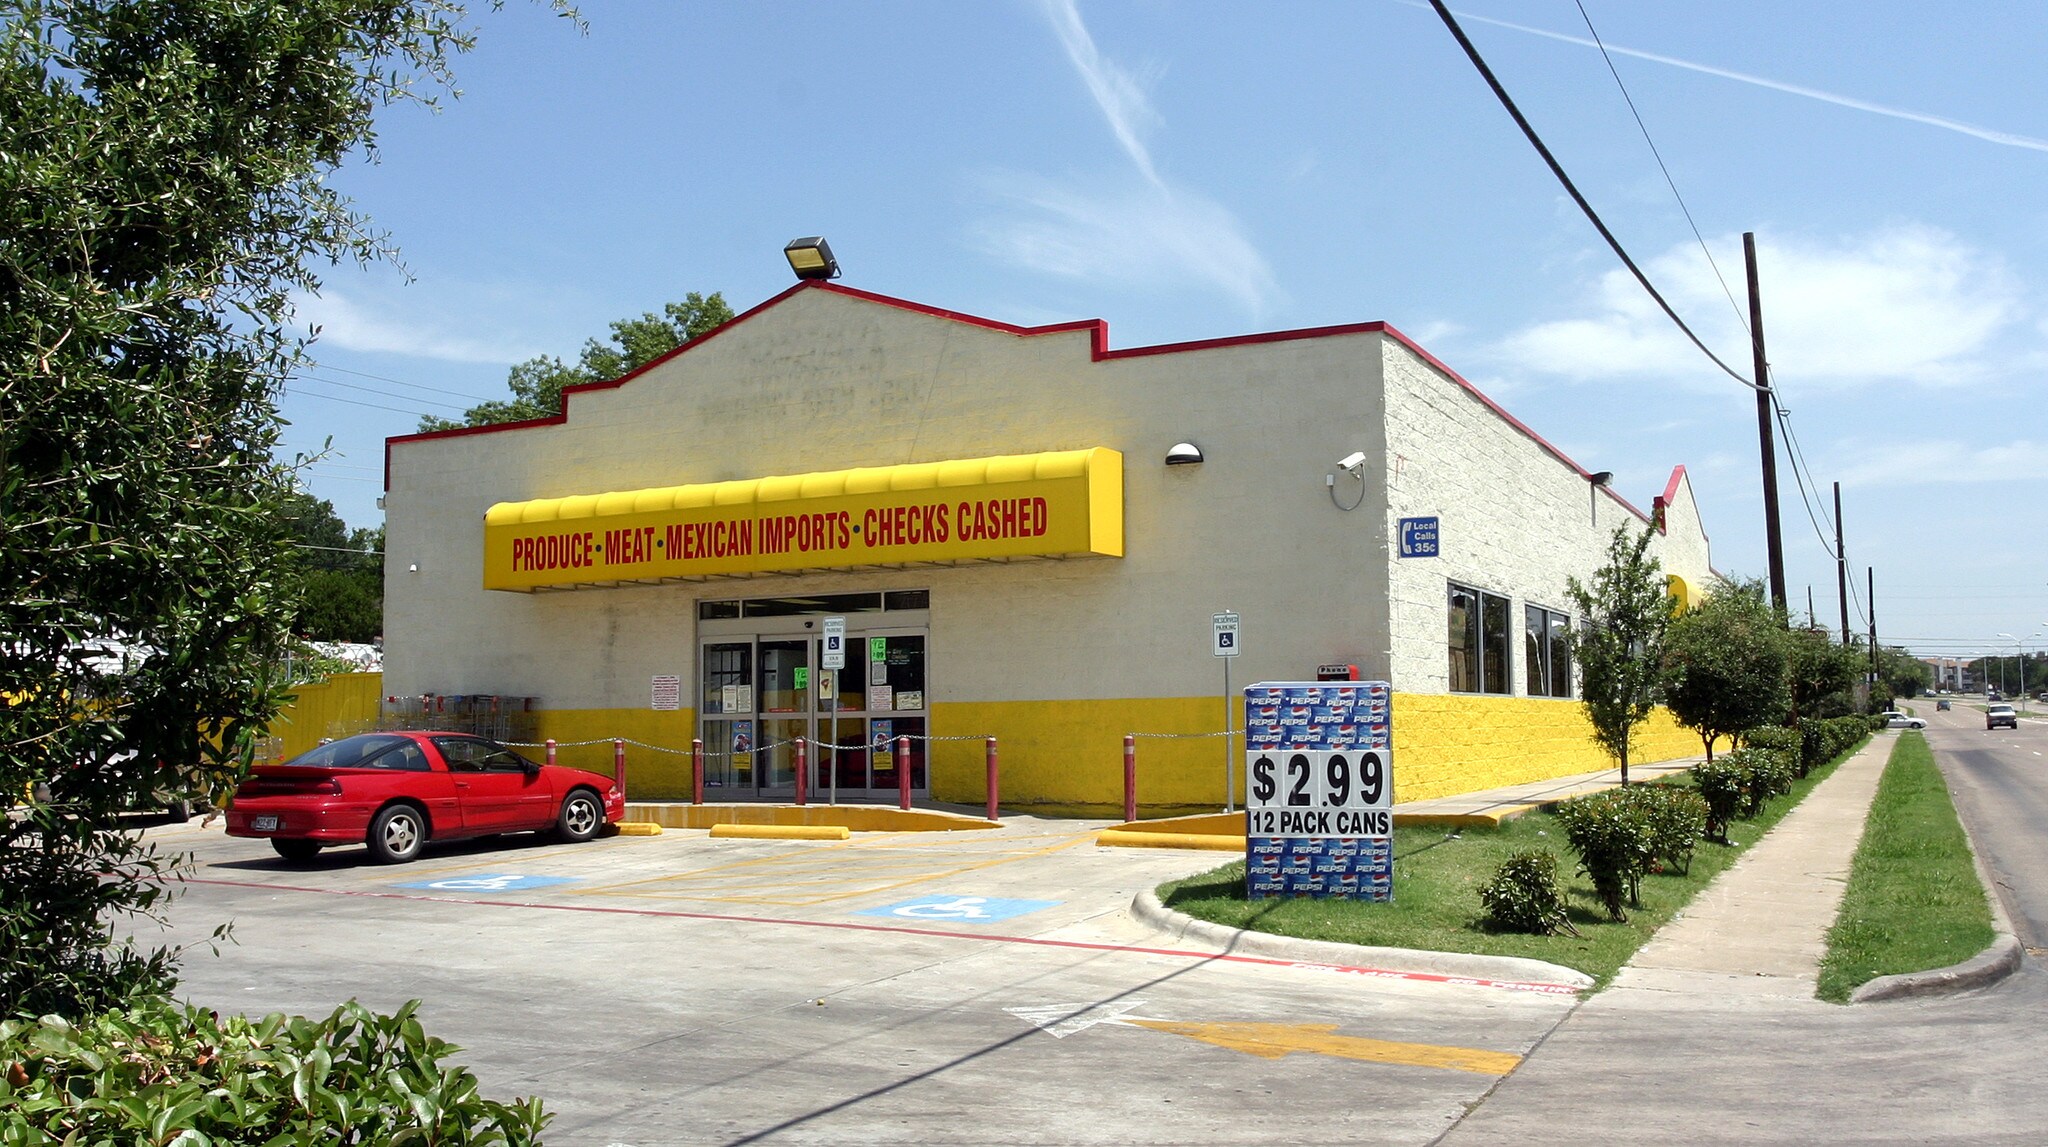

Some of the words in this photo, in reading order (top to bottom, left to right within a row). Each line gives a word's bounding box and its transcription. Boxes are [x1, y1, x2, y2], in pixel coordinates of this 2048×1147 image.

[1413, 521, 1437, 530] Local
[512, 532, 593, 572] PRODUCE
[605, 527, 655, 565] MEAT
[666, 519, 752, 560] MEXICAN
[758, 510, 850, 554] IMPORTS
[863, 503, 949, 547] CHECKS
[957, 497, 1047, 541] CASHED
[1414, 532, 1436, 540] Calls
[1251, 697, 1282, 705] PEPSI
[1290, 697, 1320, 705] PEPSI
[1326, 699, 1354, 707] PEPSI
[1358, 699, 1386, 707] PEPSI
[1249, 718, 1277, 726] PEPSI
[1280, 718, 1308, 726] PEPSI
[1353, 715, 1384, 723] PEPSI
[1252, 734, 1282, 742] PEPSI
[1291, 734, 1321, 742] PEPSI
[1358, 736, 1387, 744] PEPSI
[1253, 752, 1383, 807] $2.99
[1254, 811, 1274, 833] 12
[1280, 811, 1330, 834] PACK
[1336, 811, 1389, 835] CANS
[1253, 846, 1283, 854] PEPSI
[1292, 846, 1322, 854] PEPSI
[1281, 867, 1310, 875] PEPSI
[1254, 883, 1284, 891] PEPSI
[1293, 883, 1323, 891] PEPSI
